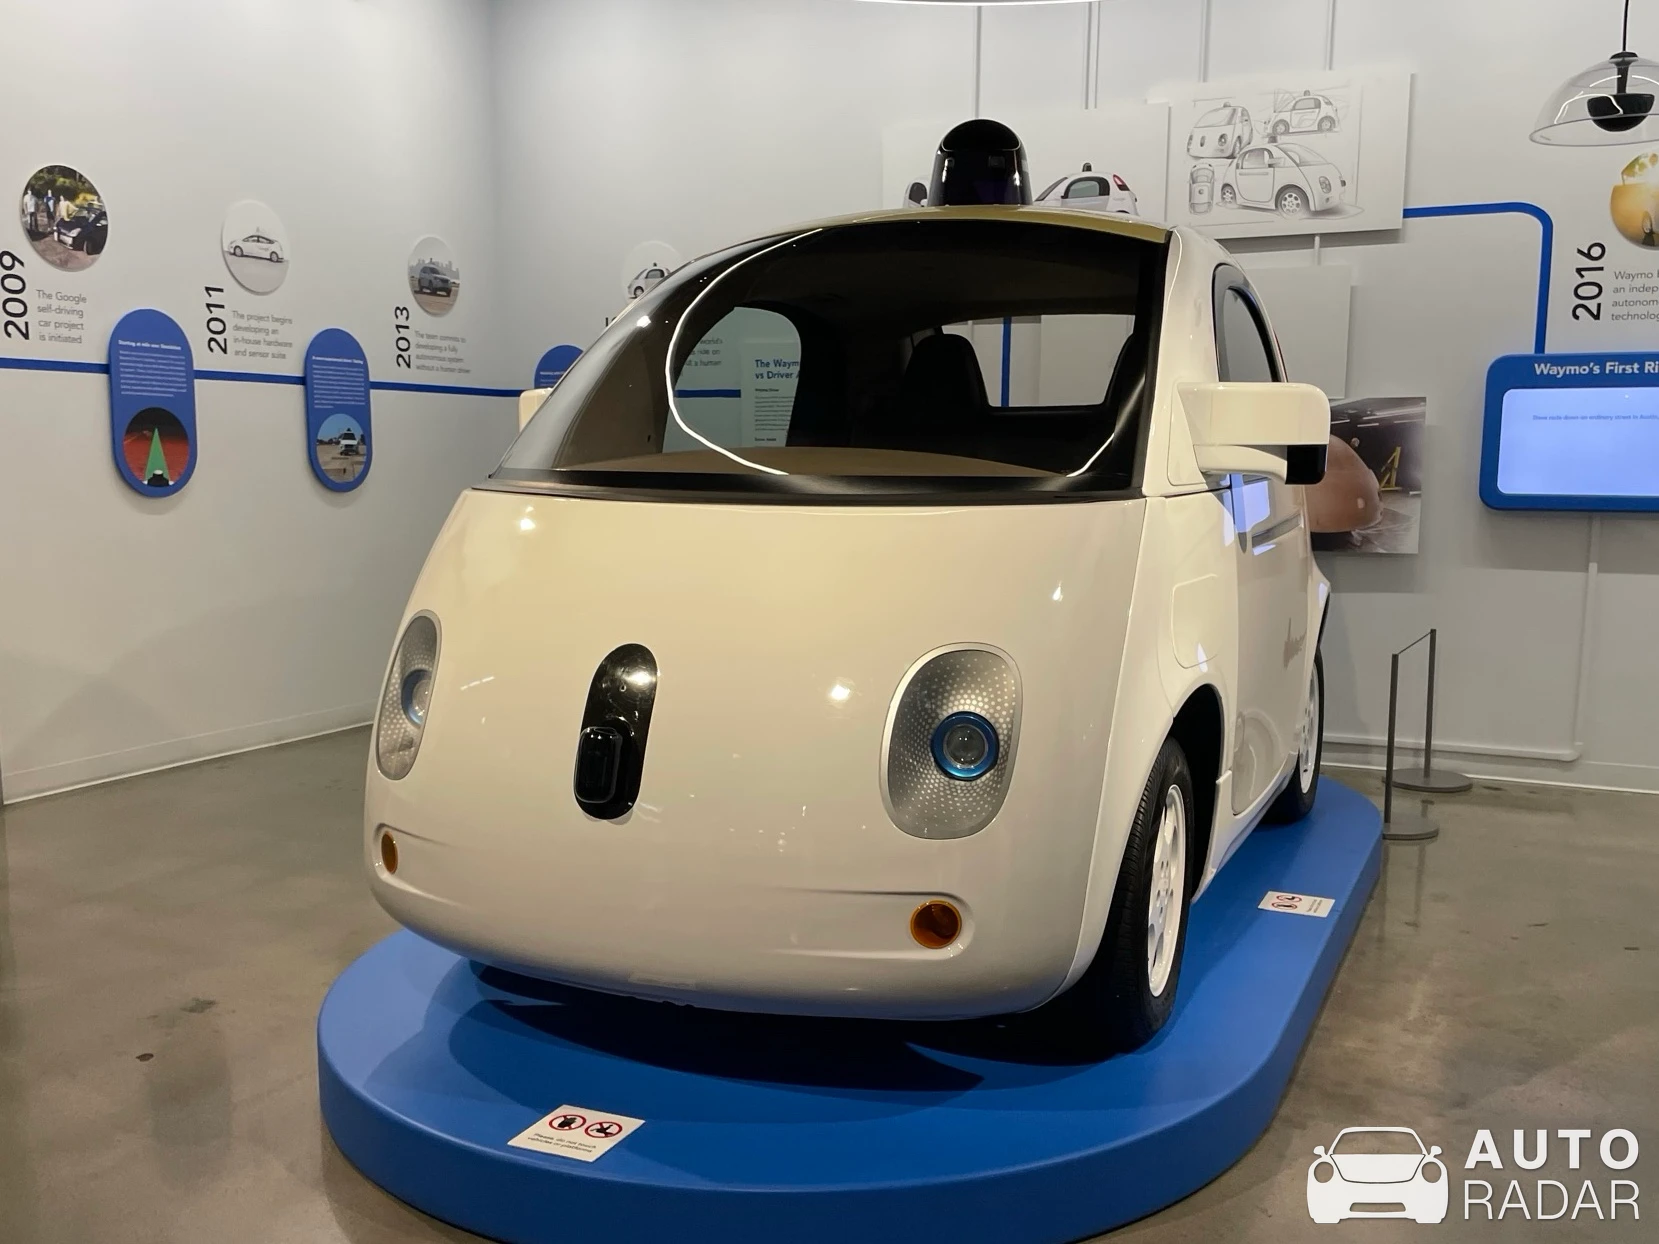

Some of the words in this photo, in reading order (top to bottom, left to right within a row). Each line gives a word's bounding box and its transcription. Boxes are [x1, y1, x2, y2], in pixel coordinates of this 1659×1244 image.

[1571, 242, 1606, 321] 2016
[1614, 271, 1654, 282] Waymo
[0, 250, 30, 341] 2009
[1628, 284, 1659, 294] indep
[36, 289, 53, 300] The
[55, 291, 87, 305] Google
[37, 303, 84, 319] self-driving
[54, 320, 85, 331] project
[204, 286, 228, 355] 2011
[39, 332, 46, 341] is
[48, 332, 82, 343] initiated
[394, 306, 411, 369] 2013
[755, 359, 771, 368] The
[1605, 361, 1640, 374] First
[766, 370, 794, 379] Driver
